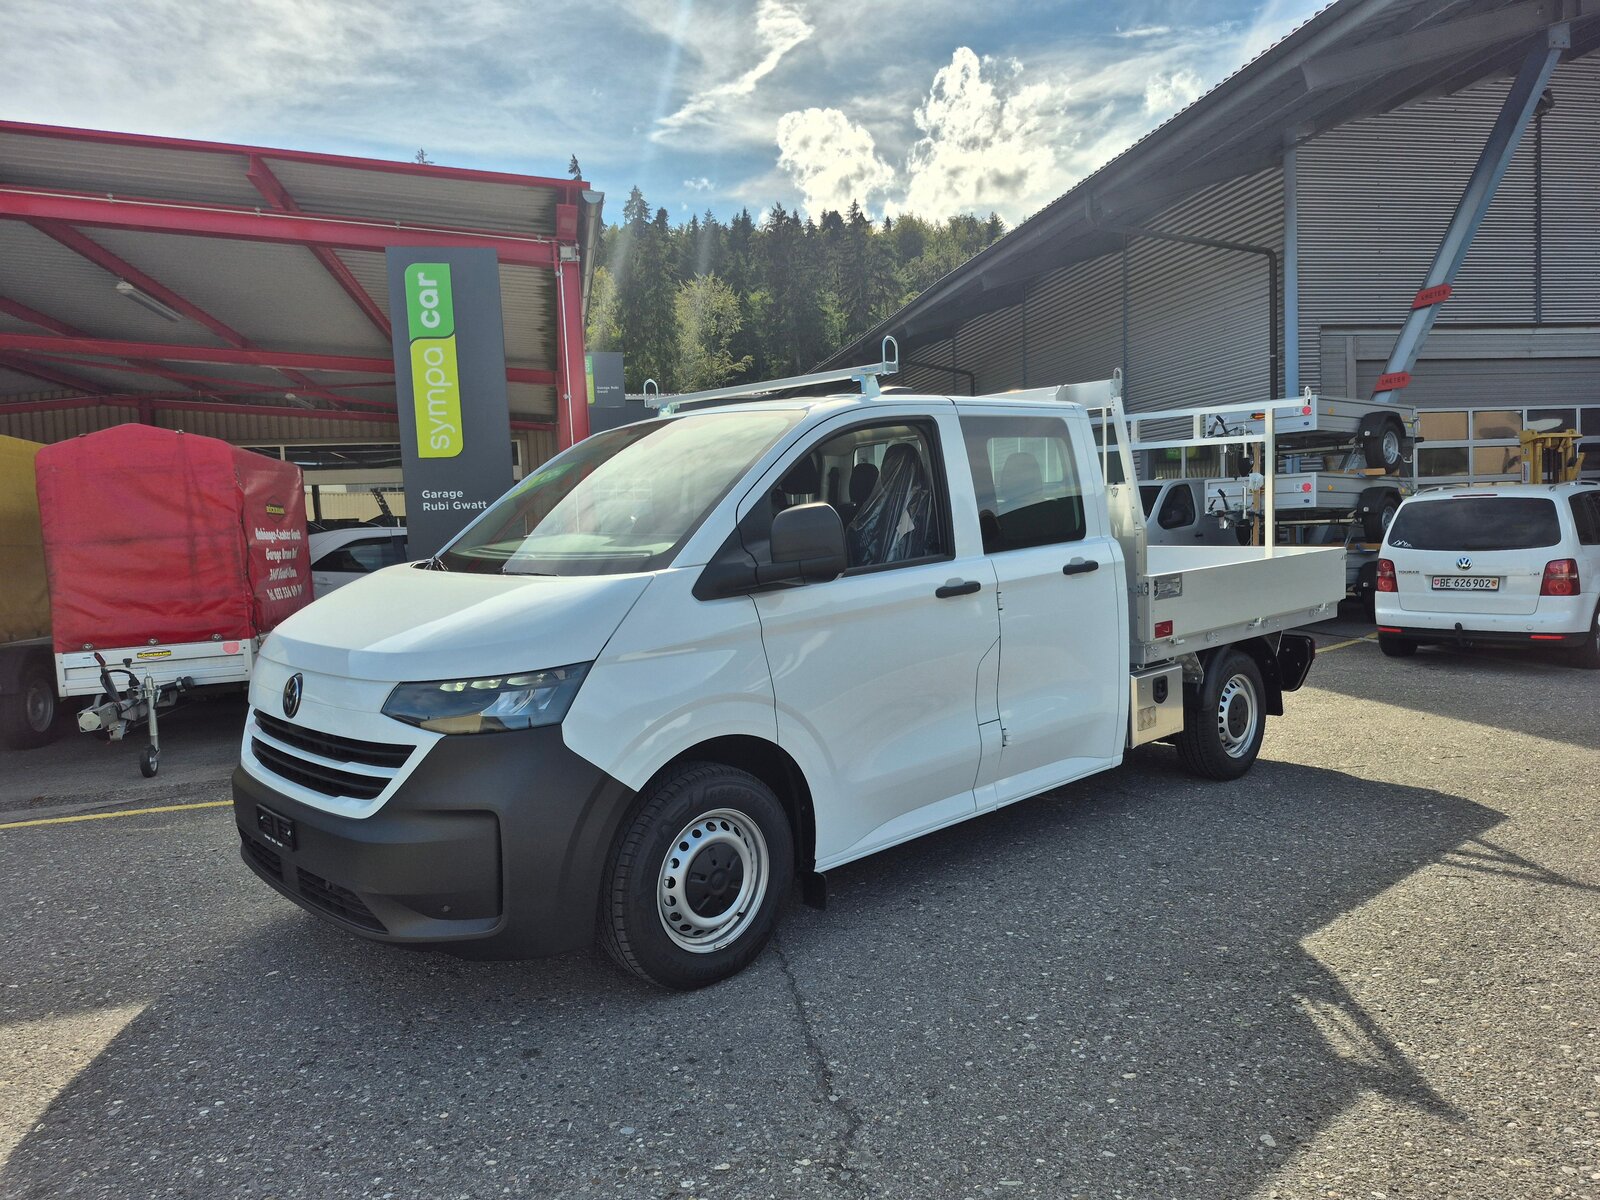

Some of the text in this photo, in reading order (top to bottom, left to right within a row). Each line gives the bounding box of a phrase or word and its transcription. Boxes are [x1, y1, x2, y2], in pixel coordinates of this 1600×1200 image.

[417, 271, 457, 449] sympa car
[422, 490, 463, 499] Garage
[423, 501, 487, 511] Rubi Gwatt
